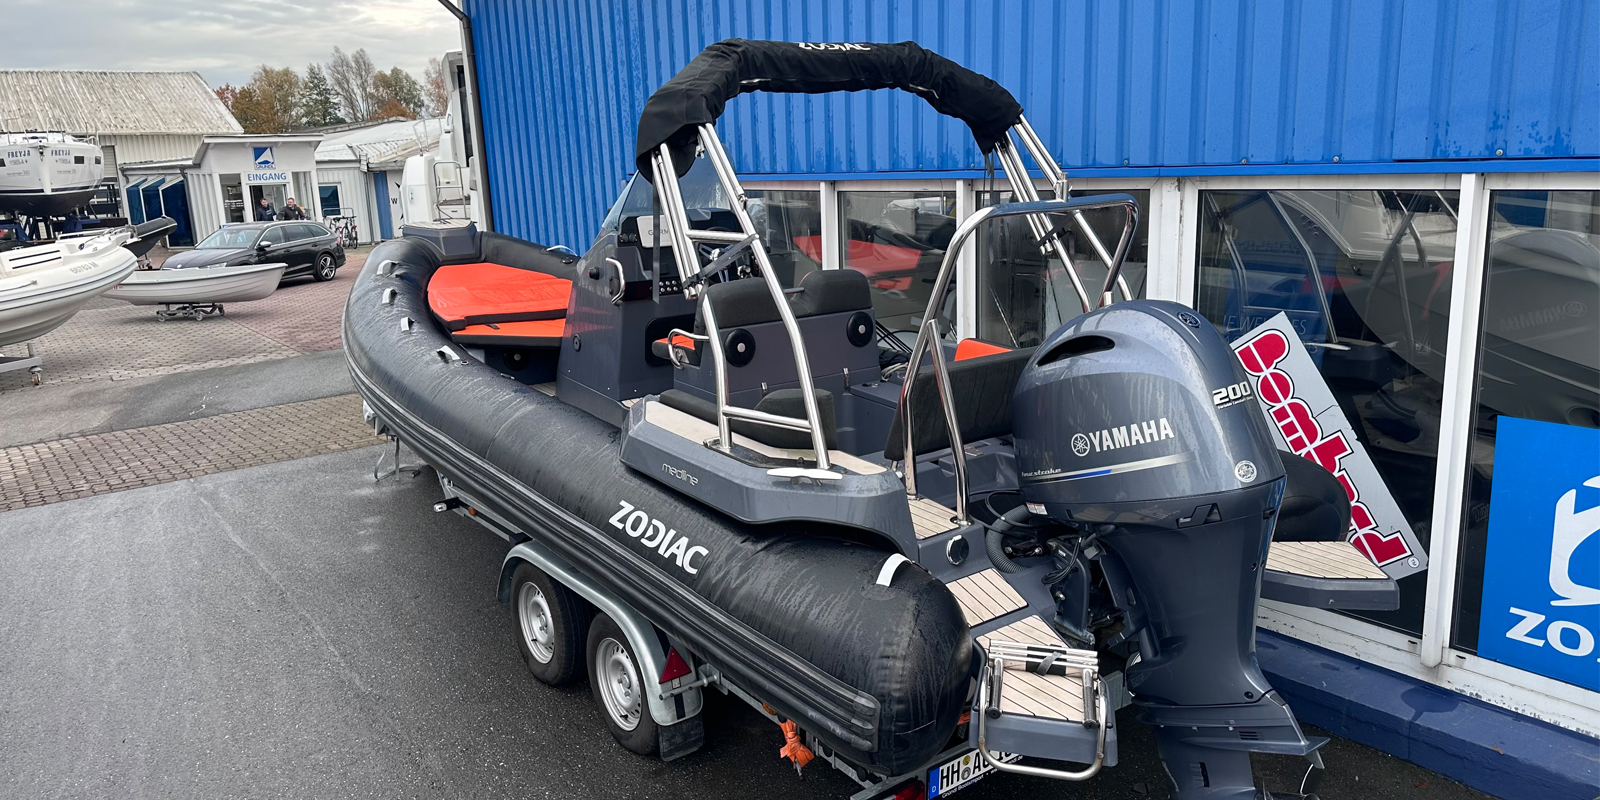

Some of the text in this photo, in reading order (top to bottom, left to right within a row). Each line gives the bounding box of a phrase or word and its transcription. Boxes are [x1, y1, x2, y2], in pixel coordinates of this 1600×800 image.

[7, 150, 31, 158] FREYJA
[247, 172, 287, 182] EINGANG
[1212, 381, 1251, 405] 200
[1089, 417, 1175, 453] YAMAHA
[661, 463, 699, 486] medline
[608, 499, 710, 575] ZODIAC
[1505, 606, 1600, 663] ZO
[940, 760, 961, 790] HH
